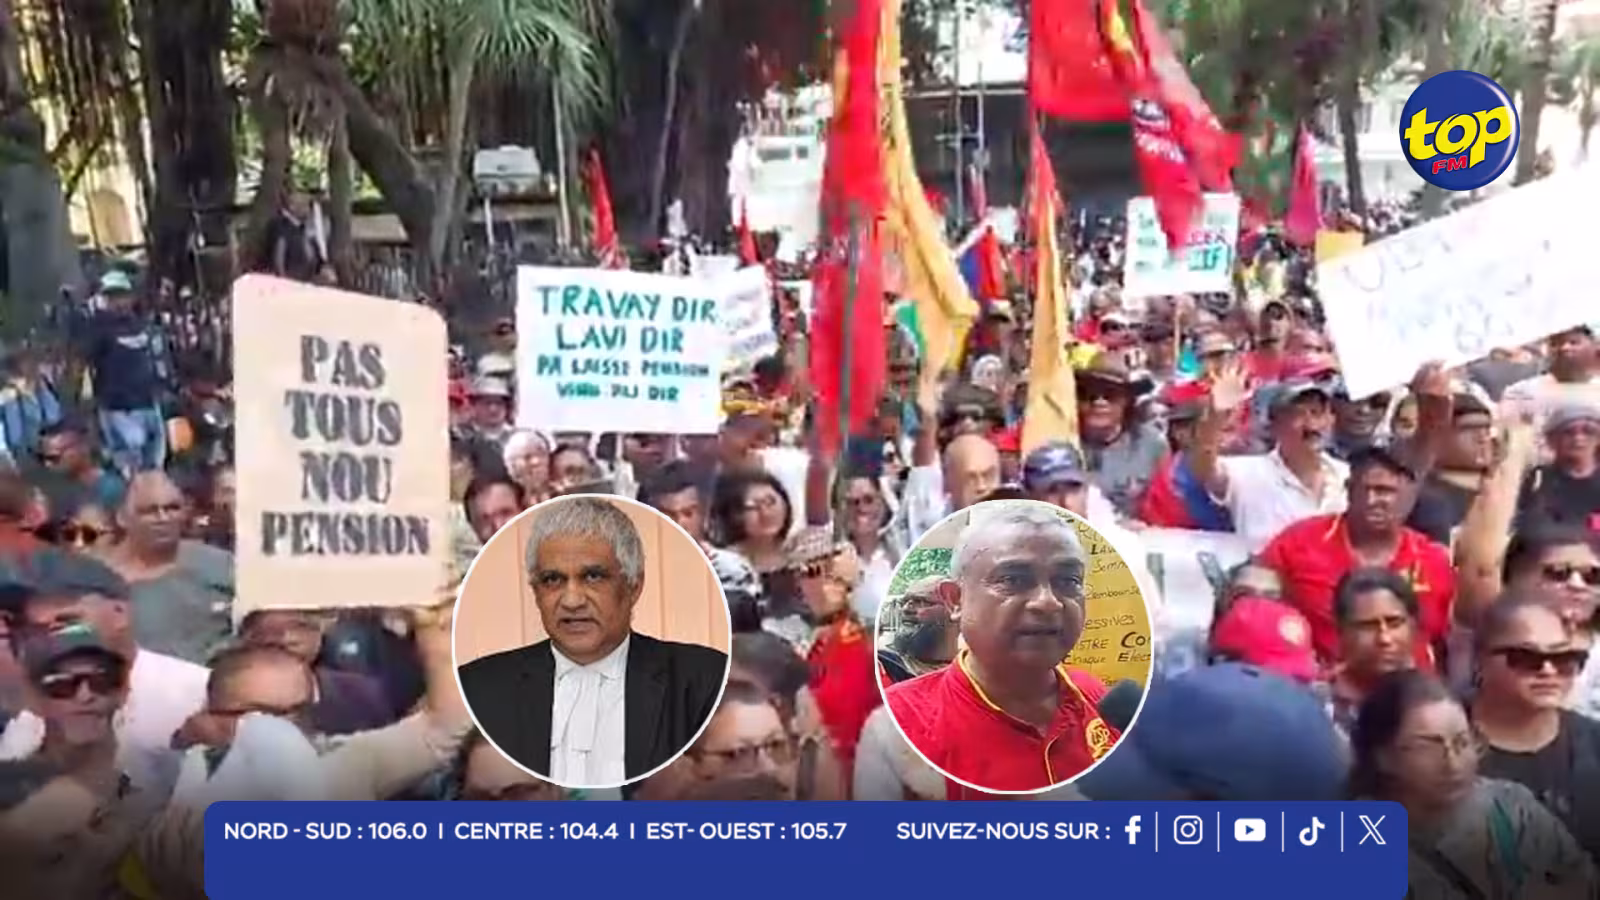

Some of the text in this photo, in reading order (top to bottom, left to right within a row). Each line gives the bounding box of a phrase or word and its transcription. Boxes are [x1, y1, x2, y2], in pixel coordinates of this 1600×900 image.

[535, 284, 661, 321] TRAVAY
[672, 296, 716, 323] DIR
[556, 323, 685, 353] LAVI DIR
[300, 334, 386, 391] PAS
[537, 354, 562, 376] PA
[284, 389, 403, 447] TOUS
[299, 451, 393, 504] NOU
[261, 511, 430, 557] PENSION
